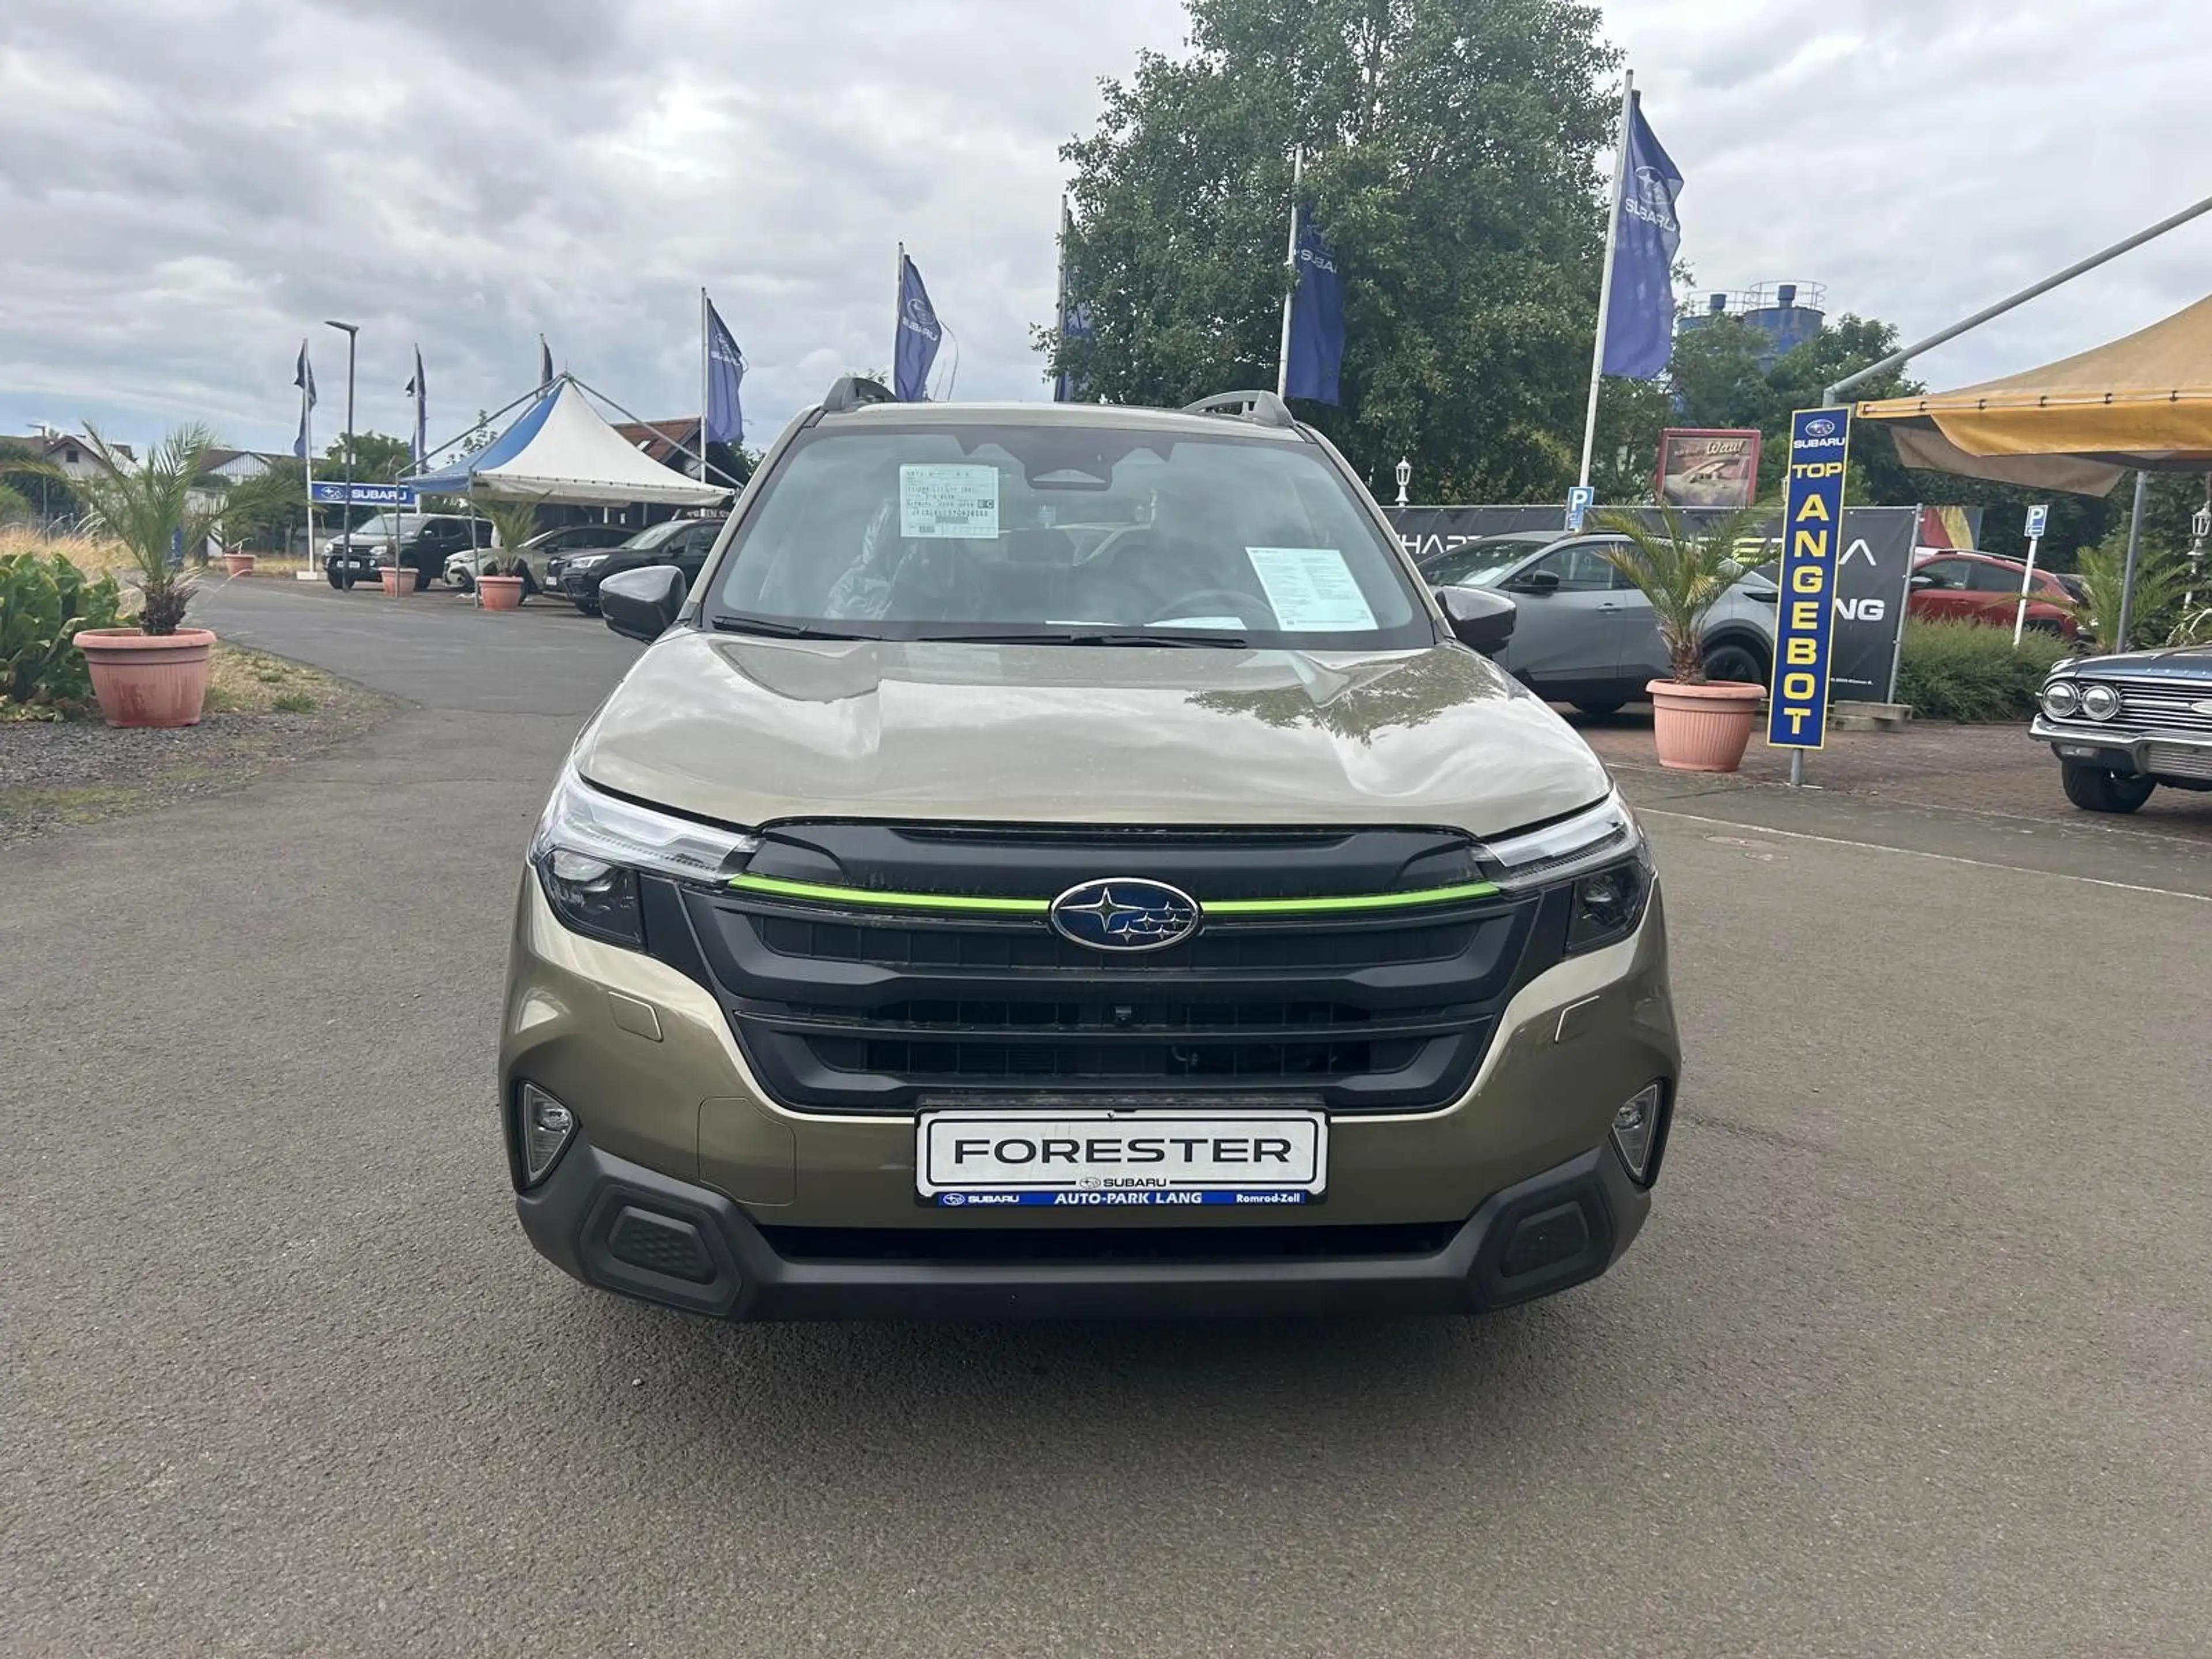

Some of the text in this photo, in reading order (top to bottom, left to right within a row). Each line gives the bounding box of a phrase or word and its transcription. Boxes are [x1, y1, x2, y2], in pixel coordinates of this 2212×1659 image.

[1626, 198, 1676, 232] SUBARU
[1793, 437, 1846, 449] SUBARU
[1792, 463, 1842, 479] TOP
[351, 488, 407, 501] SUBARU
[1571, 490, 1588, 512] P
[2030, 509, 2044, 525] P
[1783, 494, 1830, 734] ANGEBOT
[1836, 597, 1885, 622] NG
[955, 1138, 1292, 1164] FORESTER
[1103, 1177, 1167, 1188] SUBARU
[967, 1195, 1019, 1203] SUBARU
[1054, 1192, 1202, 1205] AUTO-PARK LANG
[1236, 1194, 1301, 1204] Romrod-Zell
